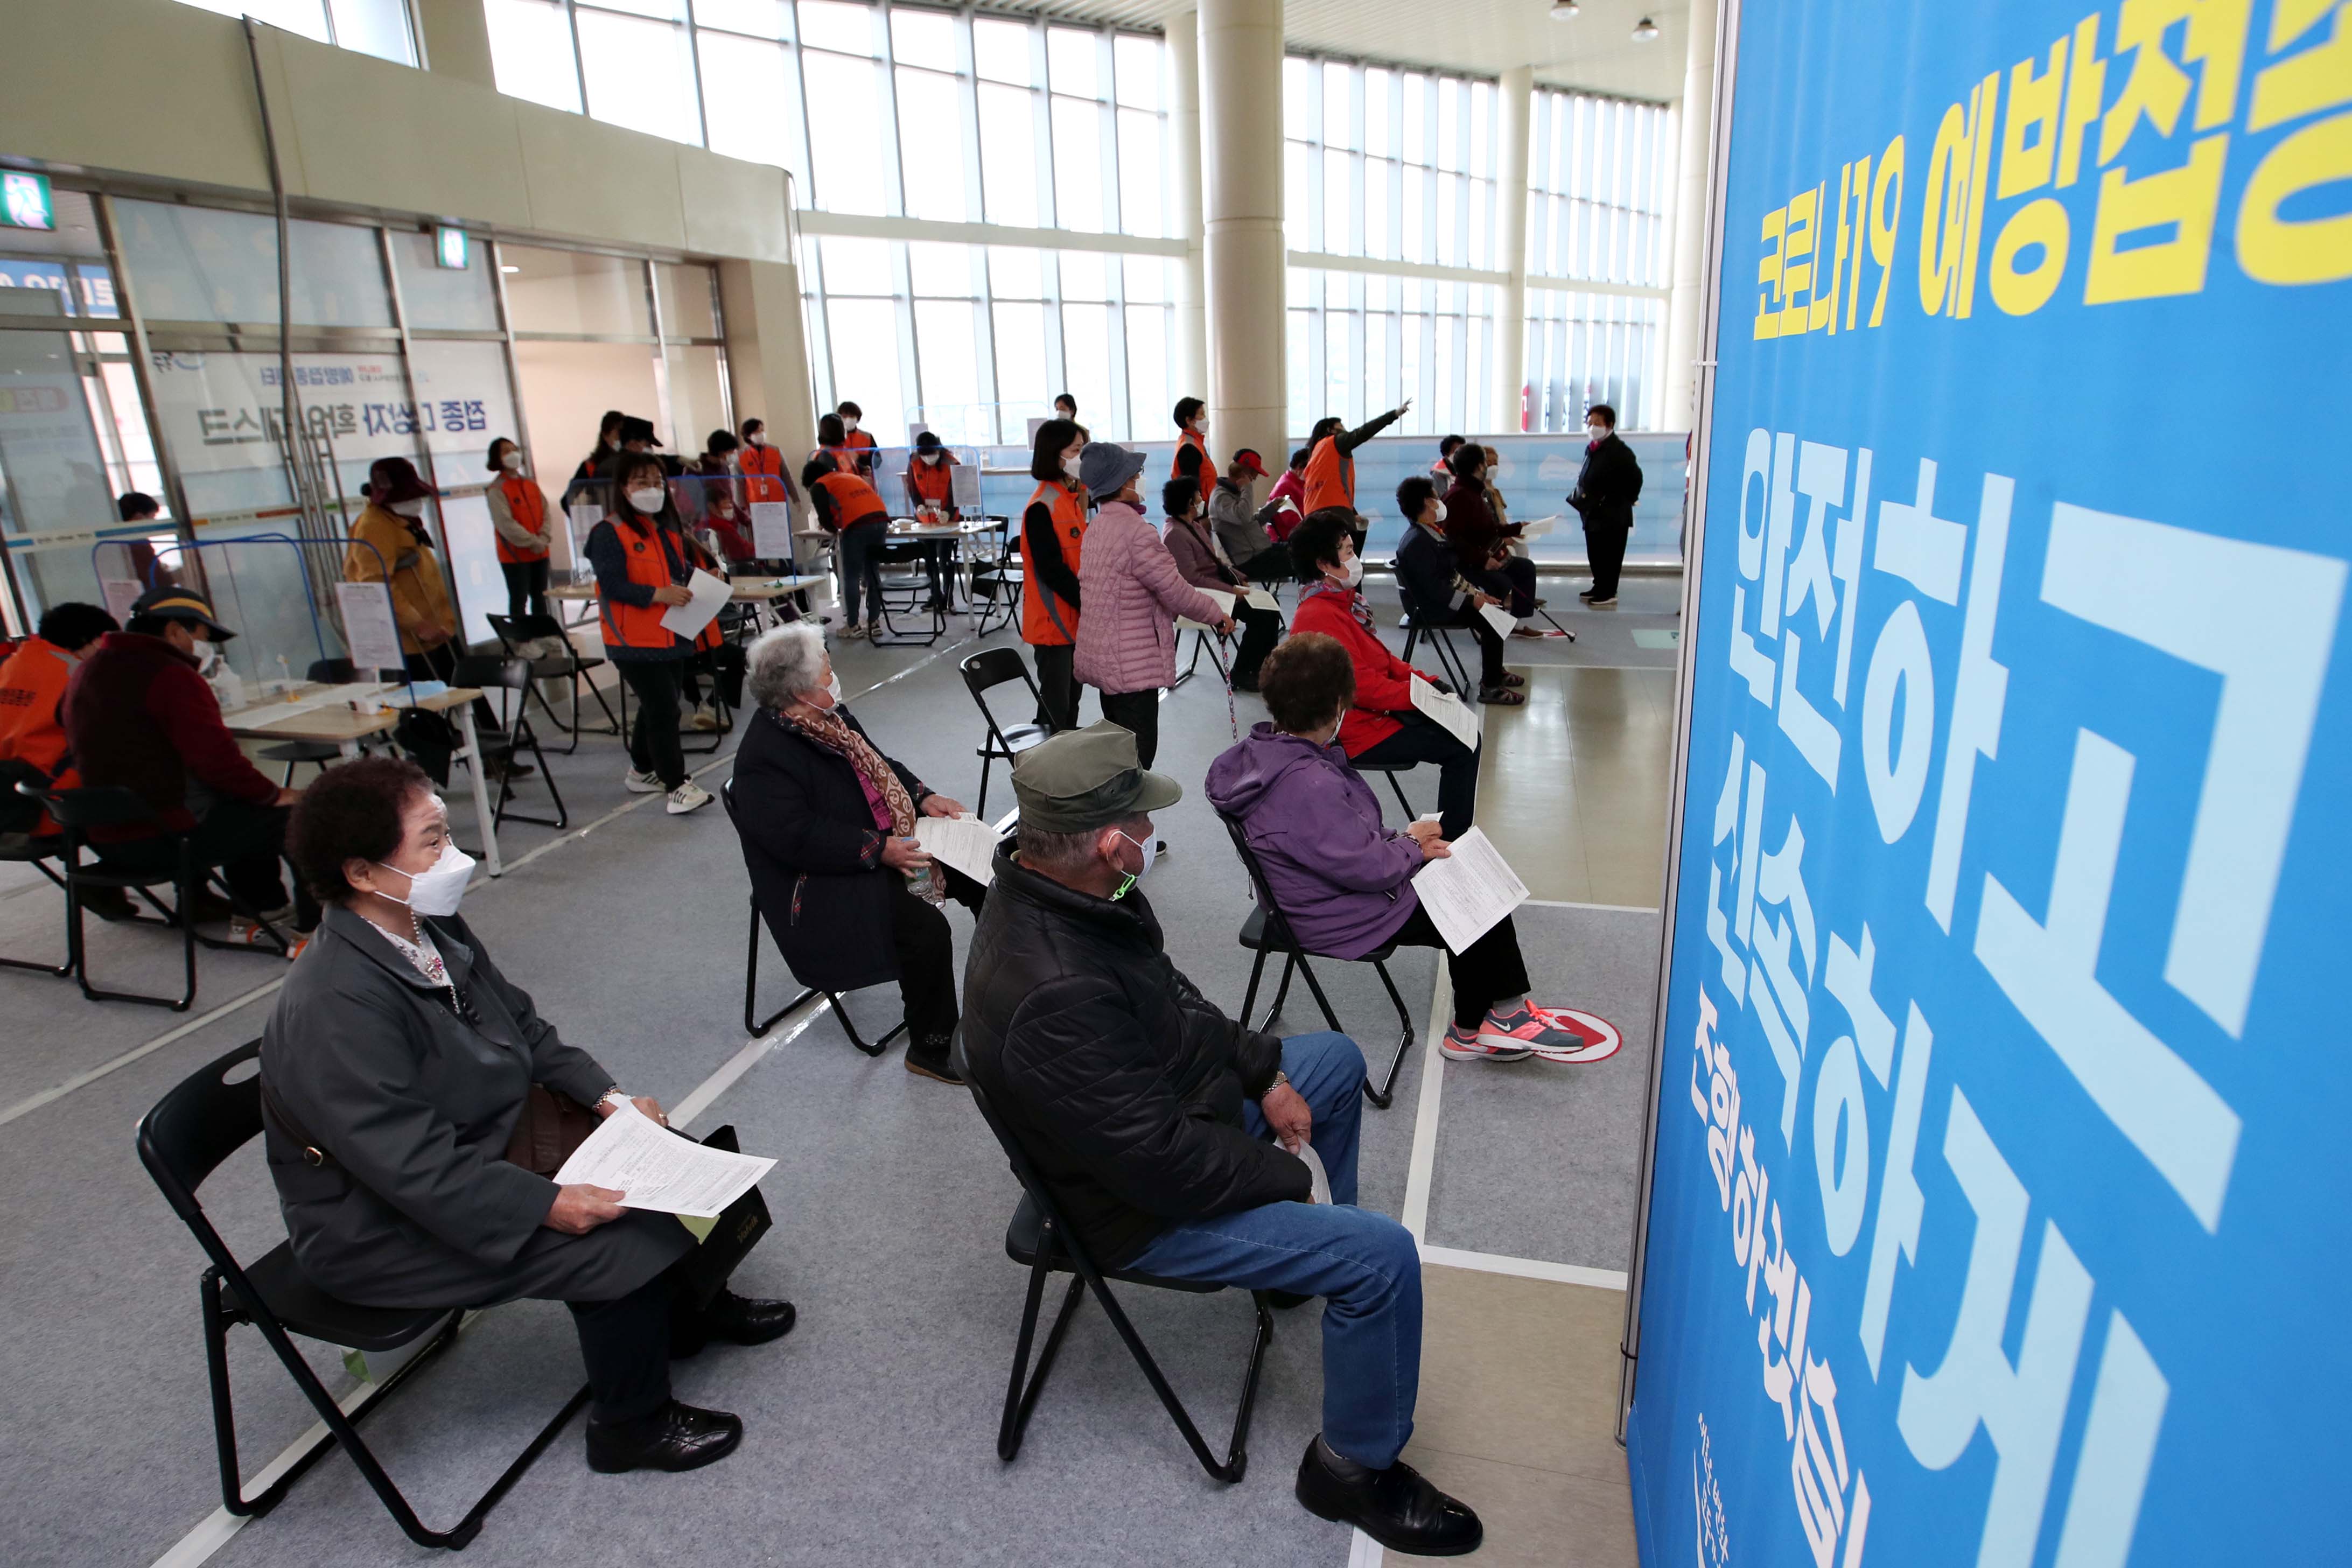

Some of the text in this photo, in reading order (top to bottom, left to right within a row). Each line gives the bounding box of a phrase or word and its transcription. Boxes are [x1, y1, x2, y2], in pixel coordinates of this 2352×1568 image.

[1753, 134, 1906, 341] 코로나19
[1706, 731, 2168, 1568] 신속하게
[1729, 428, 2348, 1232] 안전하고
[1691, 981, 1872, 1568] 진행하겠습
